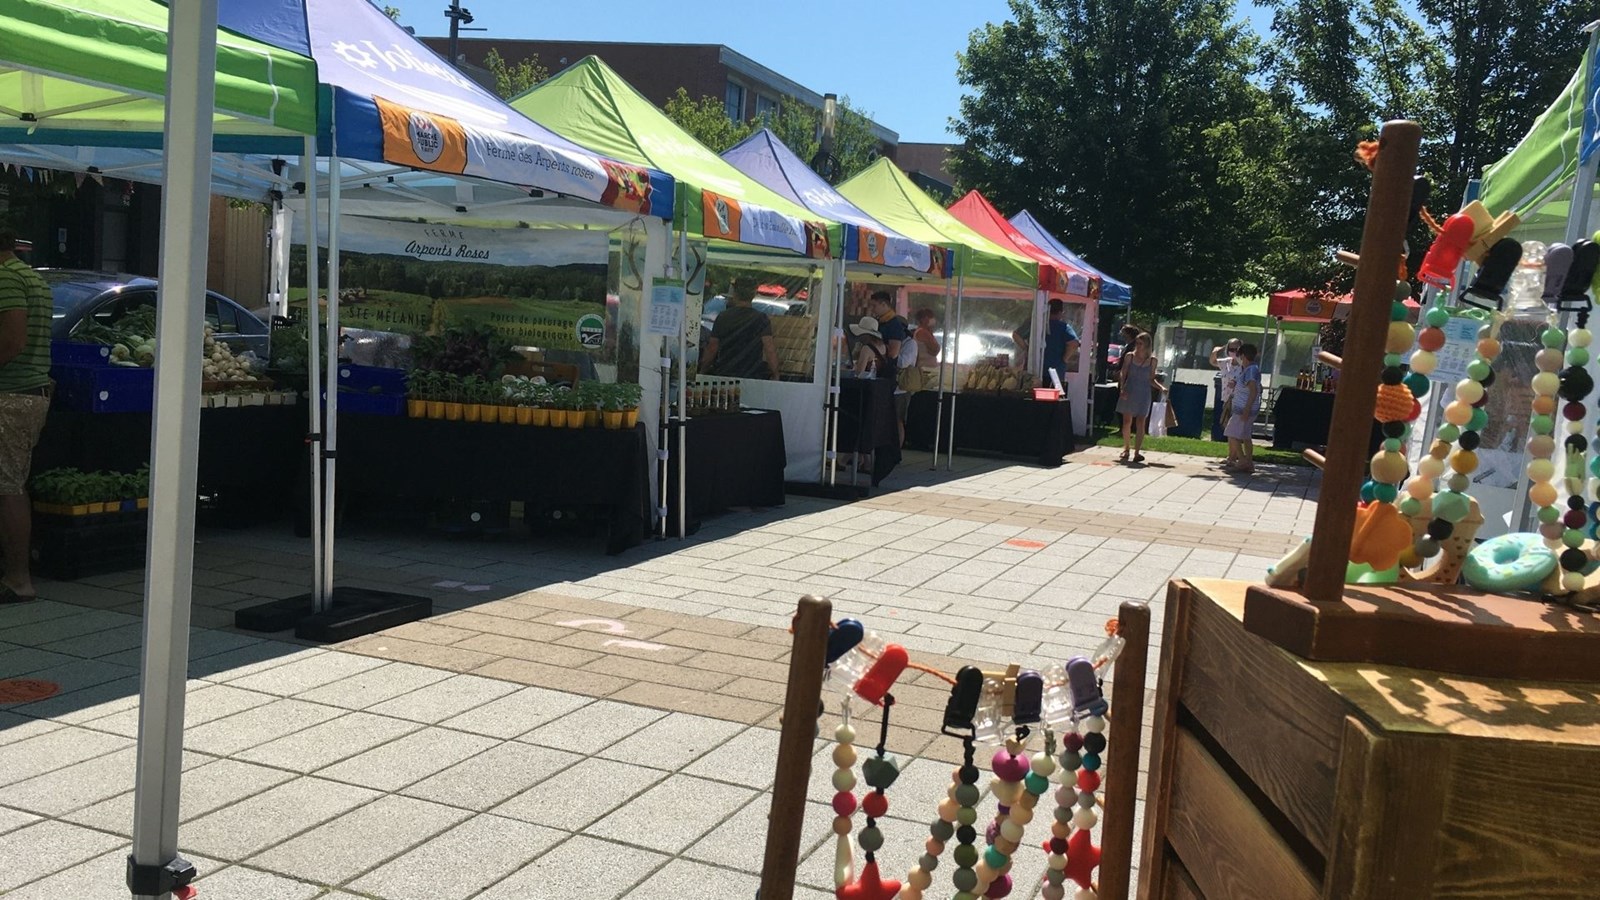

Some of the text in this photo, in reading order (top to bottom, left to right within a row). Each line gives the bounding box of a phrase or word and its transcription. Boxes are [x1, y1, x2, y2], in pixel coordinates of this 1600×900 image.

[486, 142, 516, 160] Ferme
[518, 147, 533, 164] des
[571, 166, 595, 180] roses
[424, 229, 465, 239] FERME
[405, 240, 490, 259] Arpents Roses
[519, 327, 573, 340] biologiques
